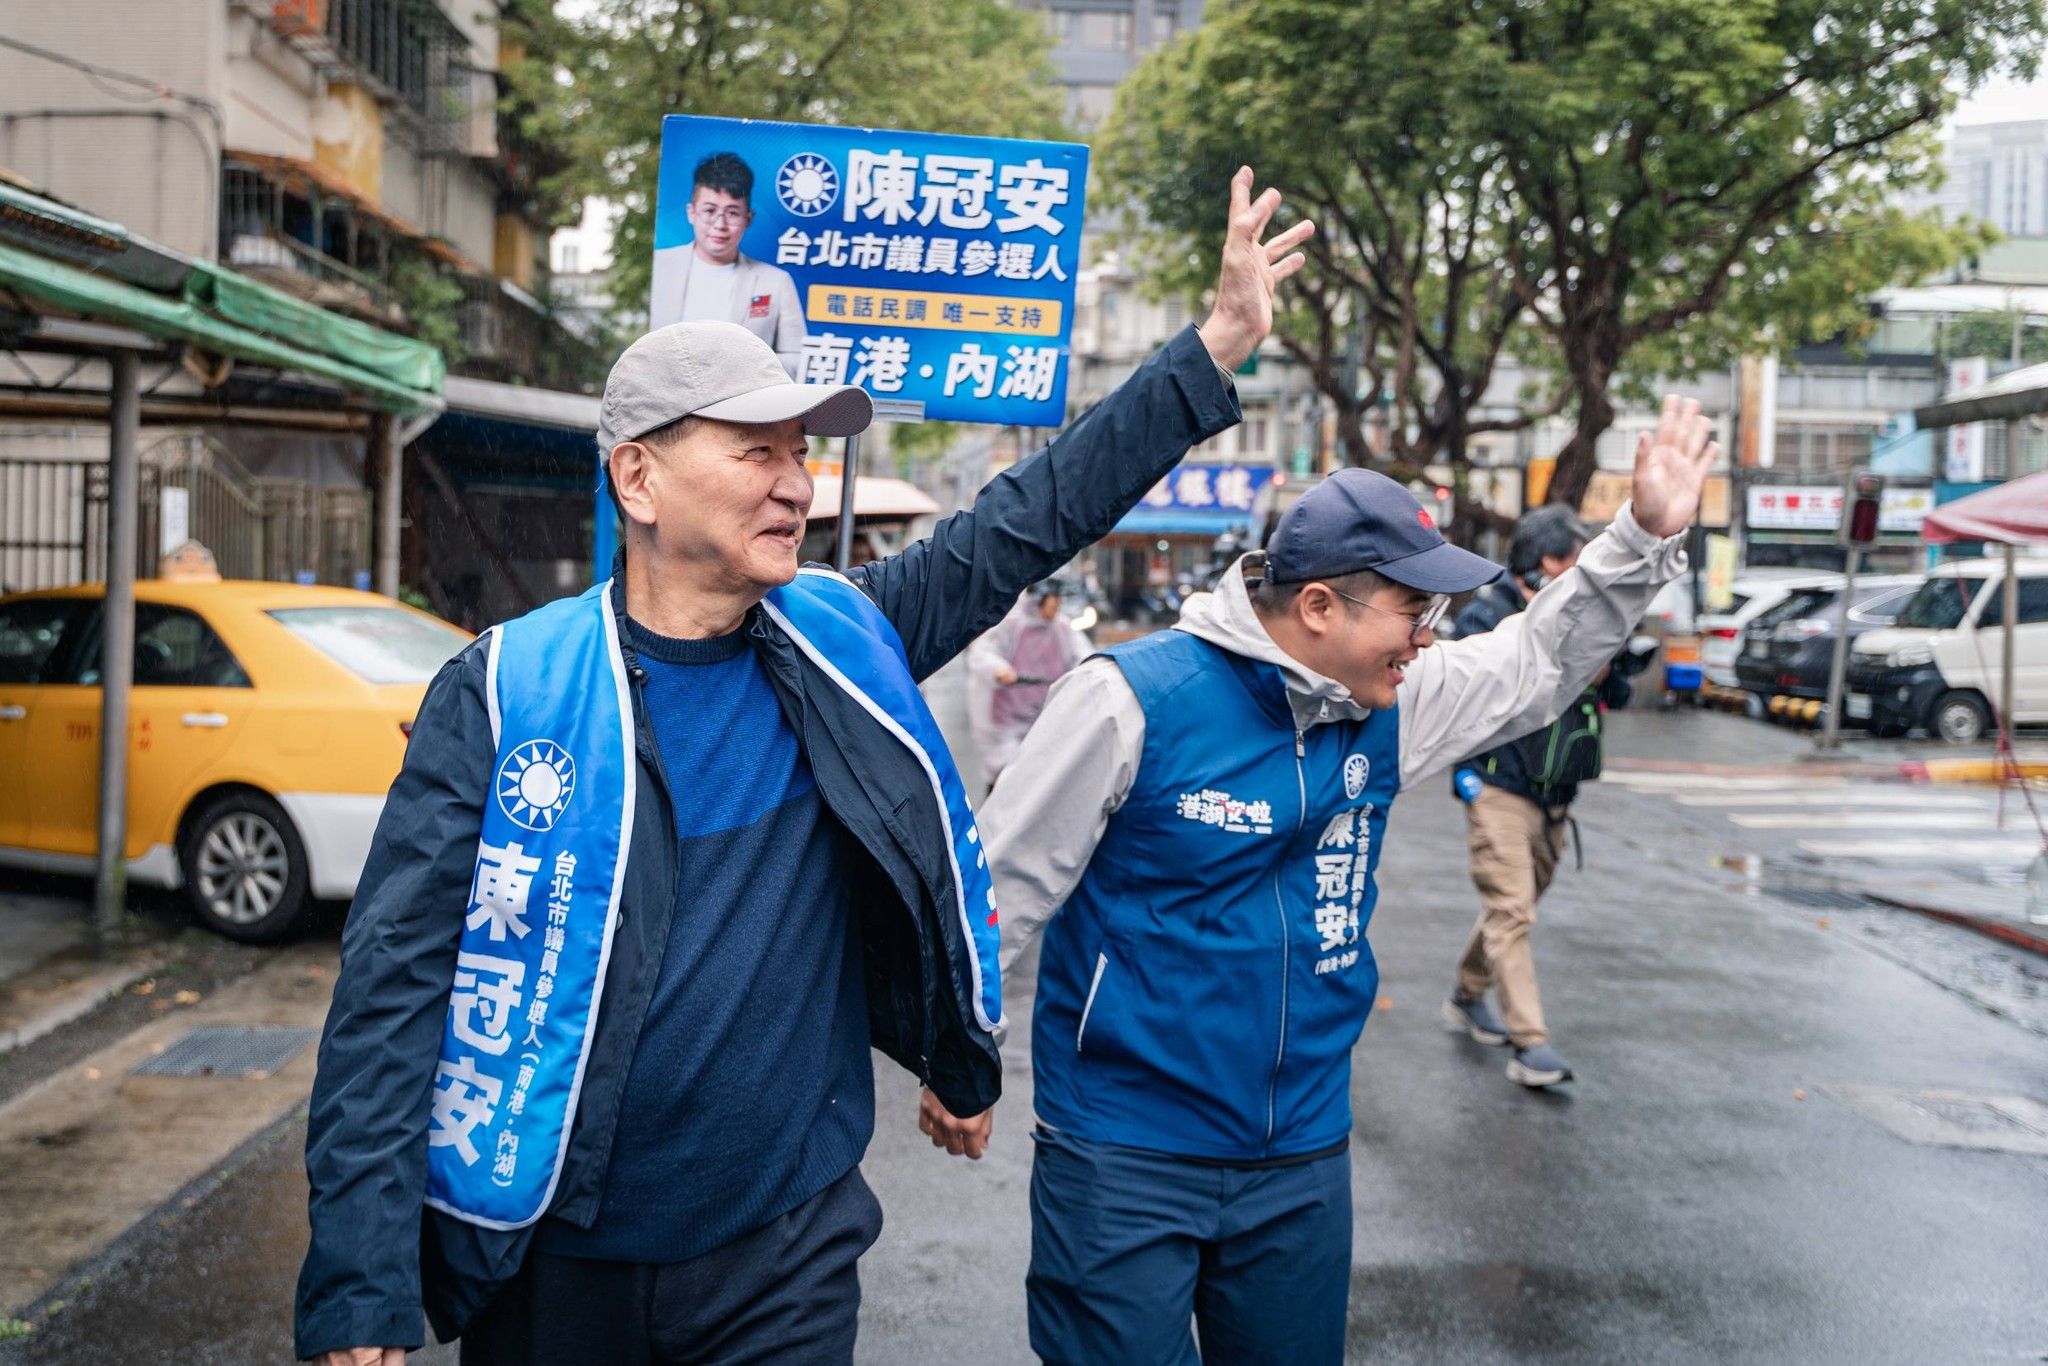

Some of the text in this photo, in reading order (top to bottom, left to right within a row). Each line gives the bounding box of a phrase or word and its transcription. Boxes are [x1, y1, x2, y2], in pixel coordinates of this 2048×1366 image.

[843, 149, 1070, 236] 陳冠安
[776, 227, 1068, 283] 台北市議員參選人
[826, 293, 1042, 329] 電話民調 唯一支持
